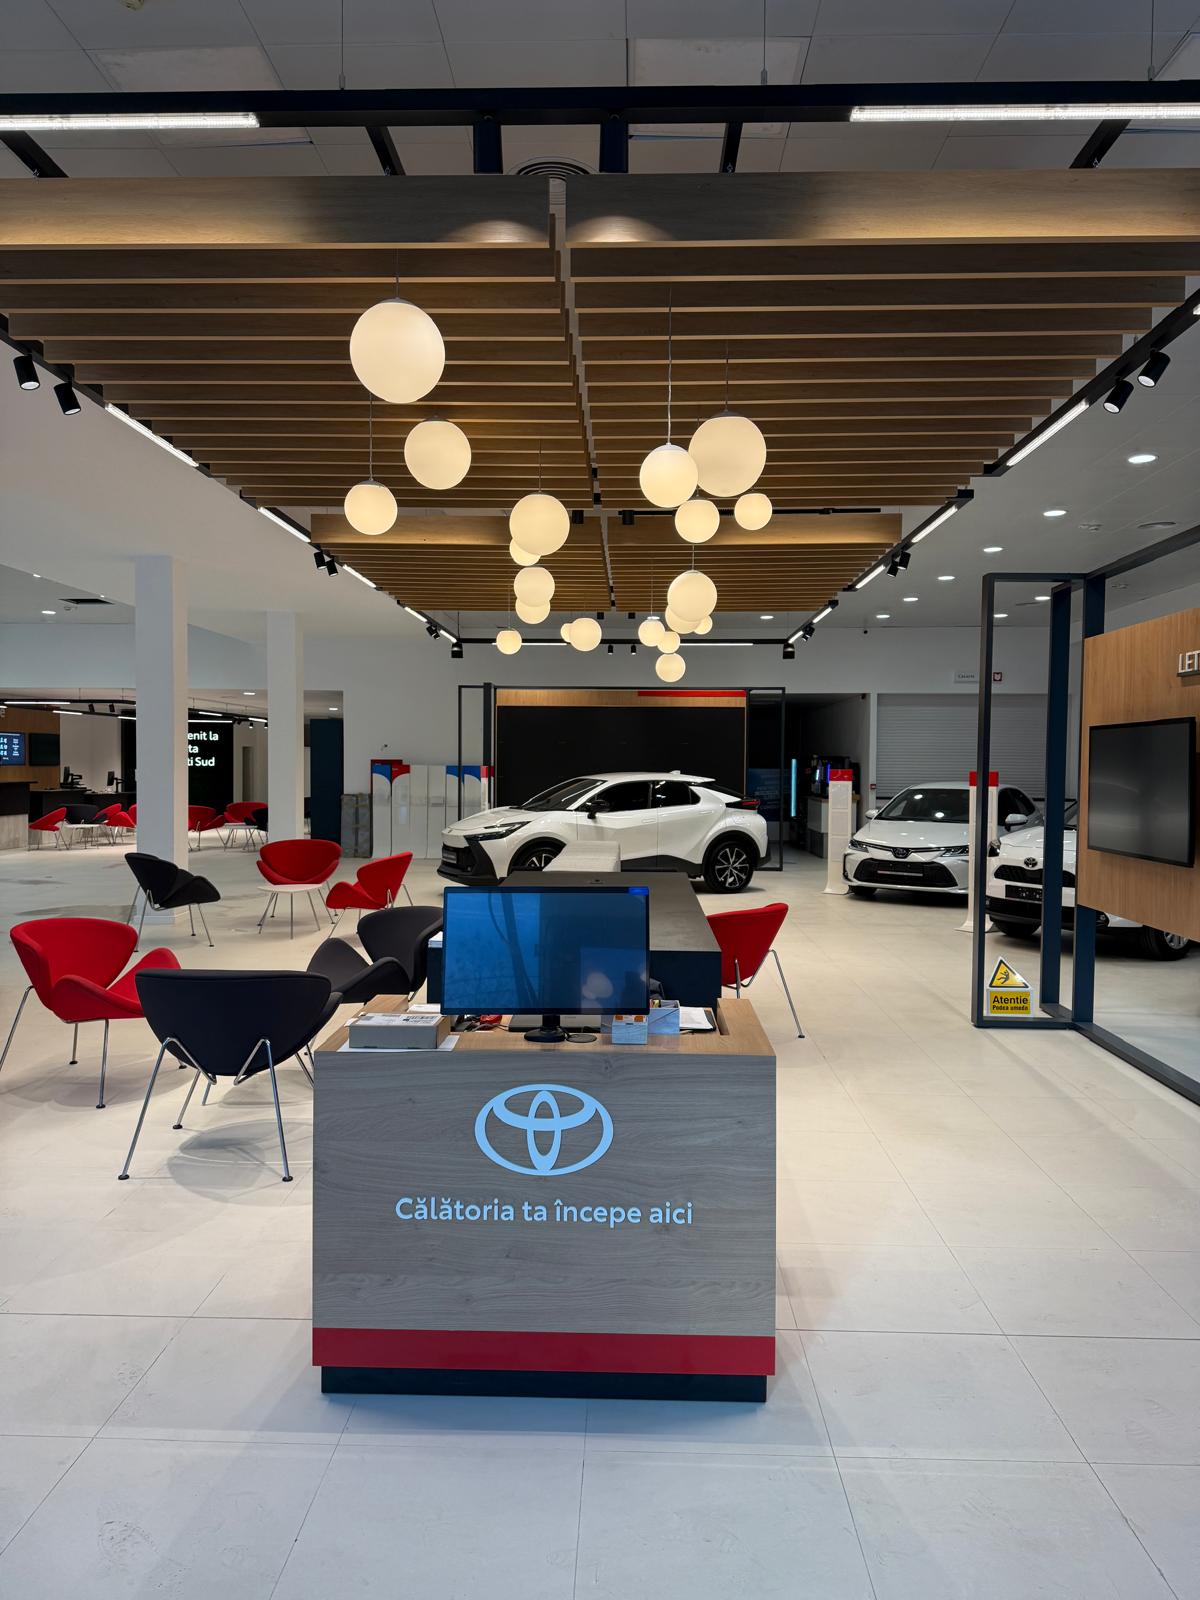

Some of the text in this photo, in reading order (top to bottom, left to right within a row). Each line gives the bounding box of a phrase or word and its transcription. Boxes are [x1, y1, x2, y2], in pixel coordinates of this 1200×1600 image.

[187, 731, 219, 741] enit la
[195, 756, 215, 767] Sud
[395, 1196, 693, 1229] Călătoria ta începe aici
